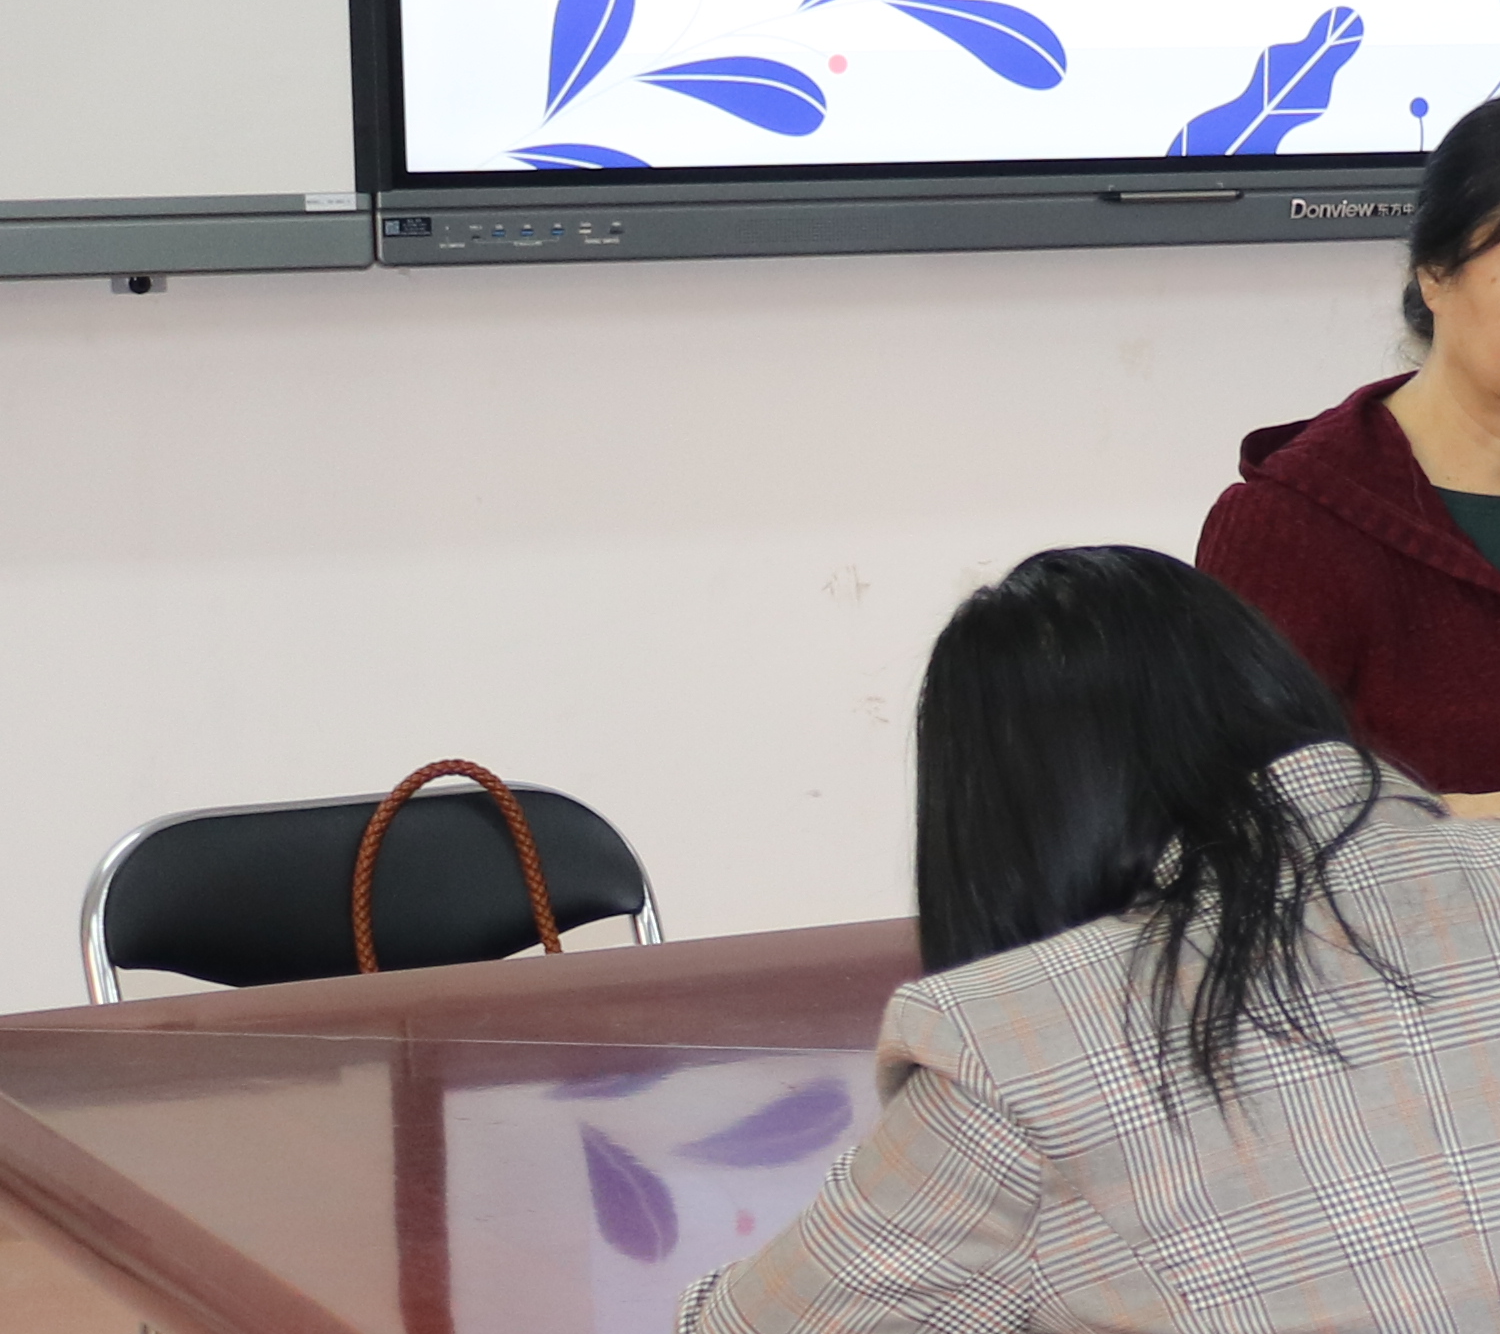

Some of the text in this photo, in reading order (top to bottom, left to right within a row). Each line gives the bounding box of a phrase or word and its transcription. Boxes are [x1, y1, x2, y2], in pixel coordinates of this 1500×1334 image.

[1290, 198, 1418, 219] Donview 东方中
